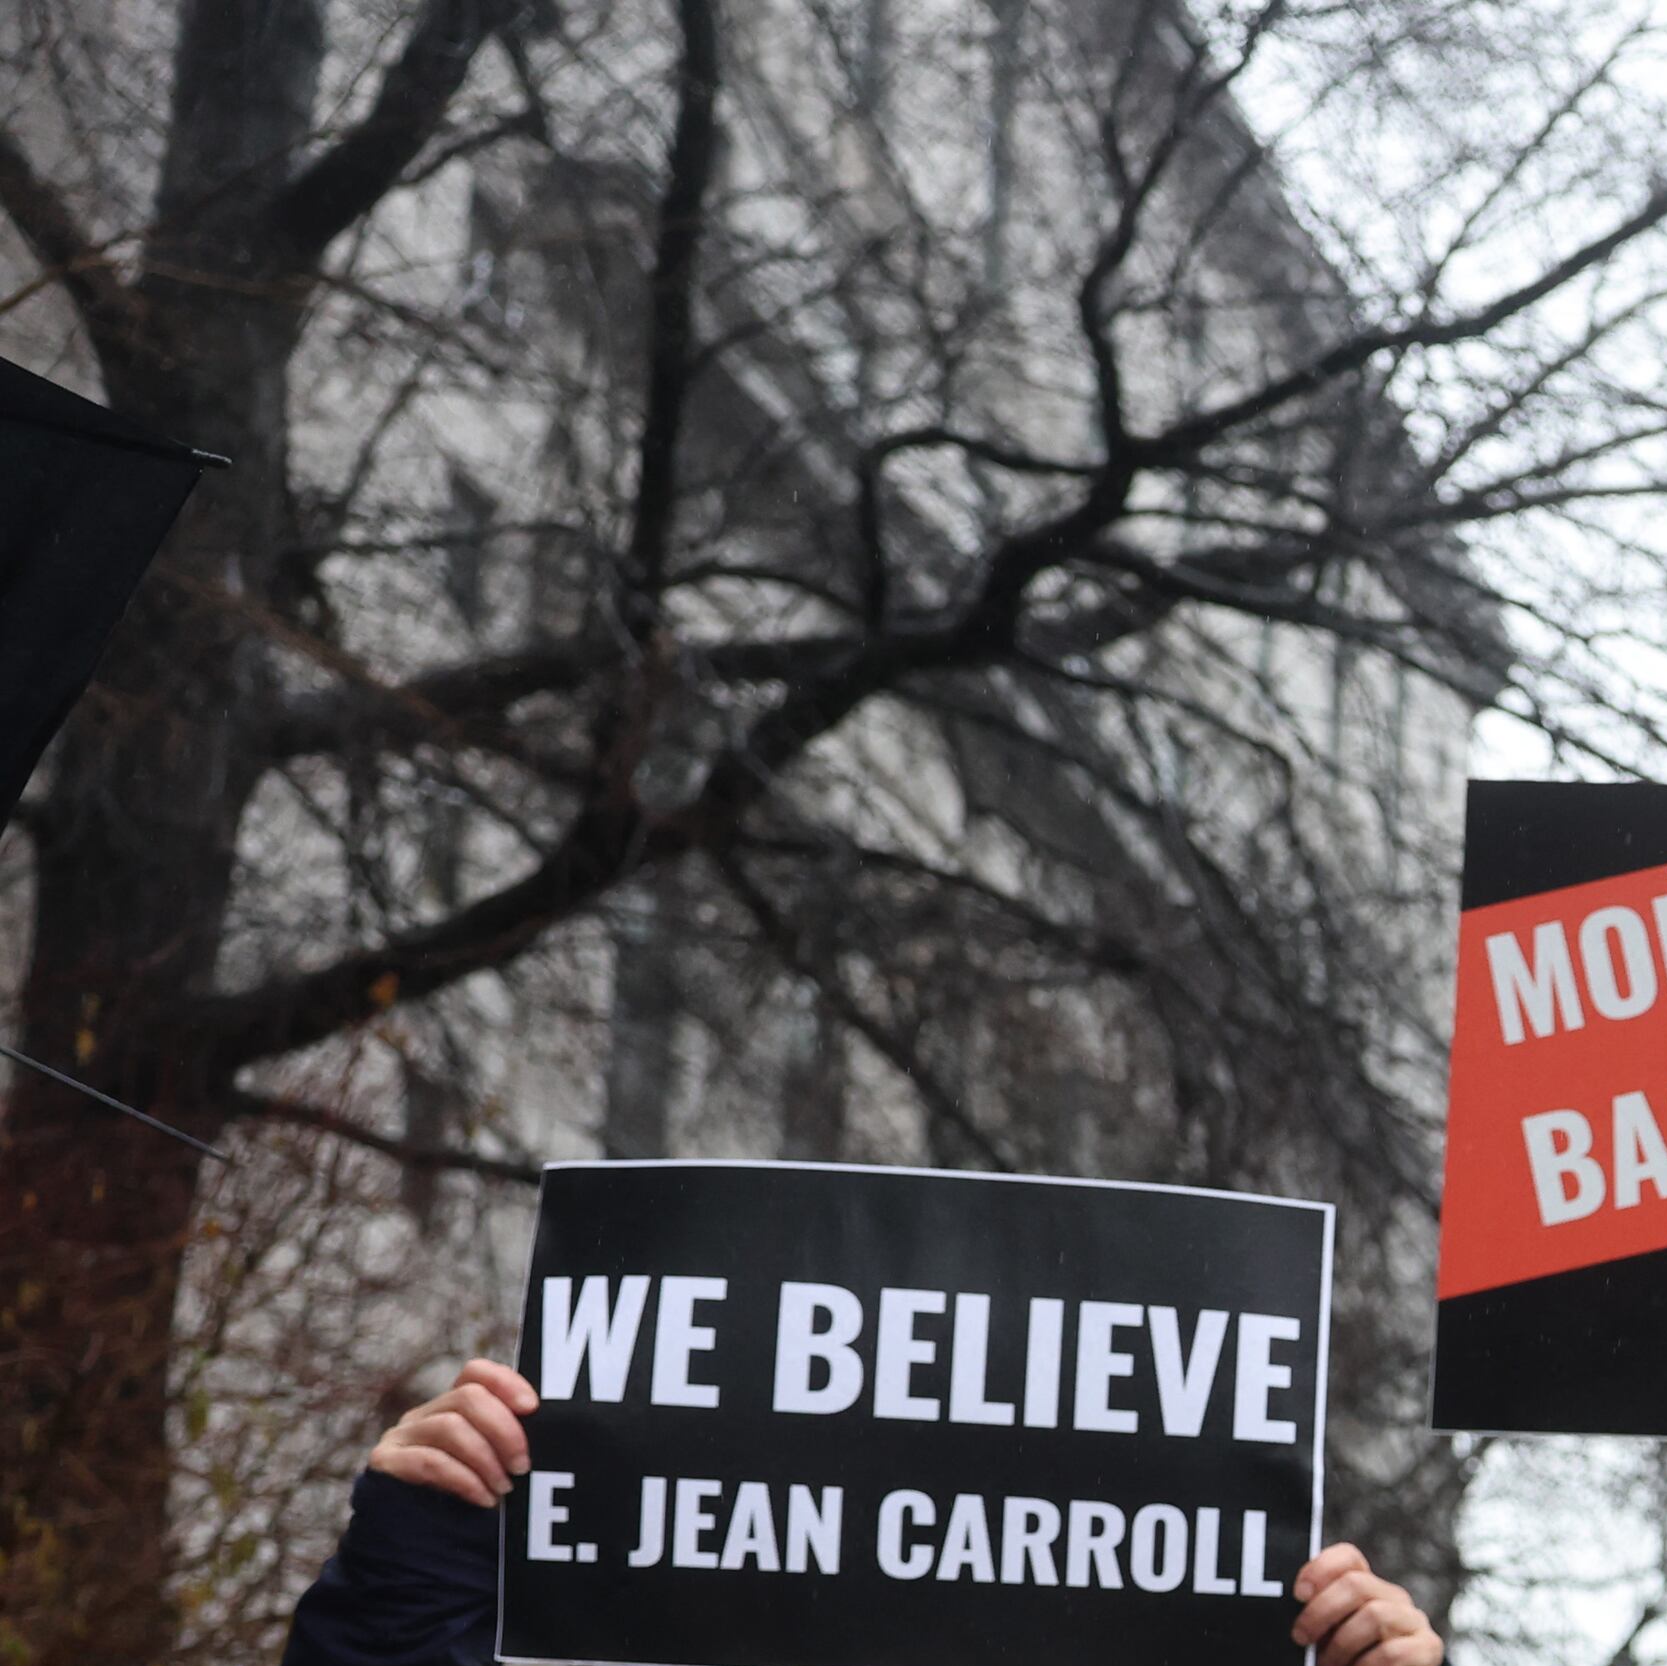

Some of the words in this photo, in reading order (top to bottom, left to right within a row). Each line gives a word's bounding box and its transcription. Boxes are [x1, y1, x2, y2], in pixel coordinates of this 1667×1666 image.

[540, 1274, 729, 1409] WE
[771, 1280, 1302, 1446] BELIEVE
[526, 1470, 599, 1564] E.
[627, 1475, 844, 1576] JEAN
[876, 1488, 1285, 1598] CARROLL
